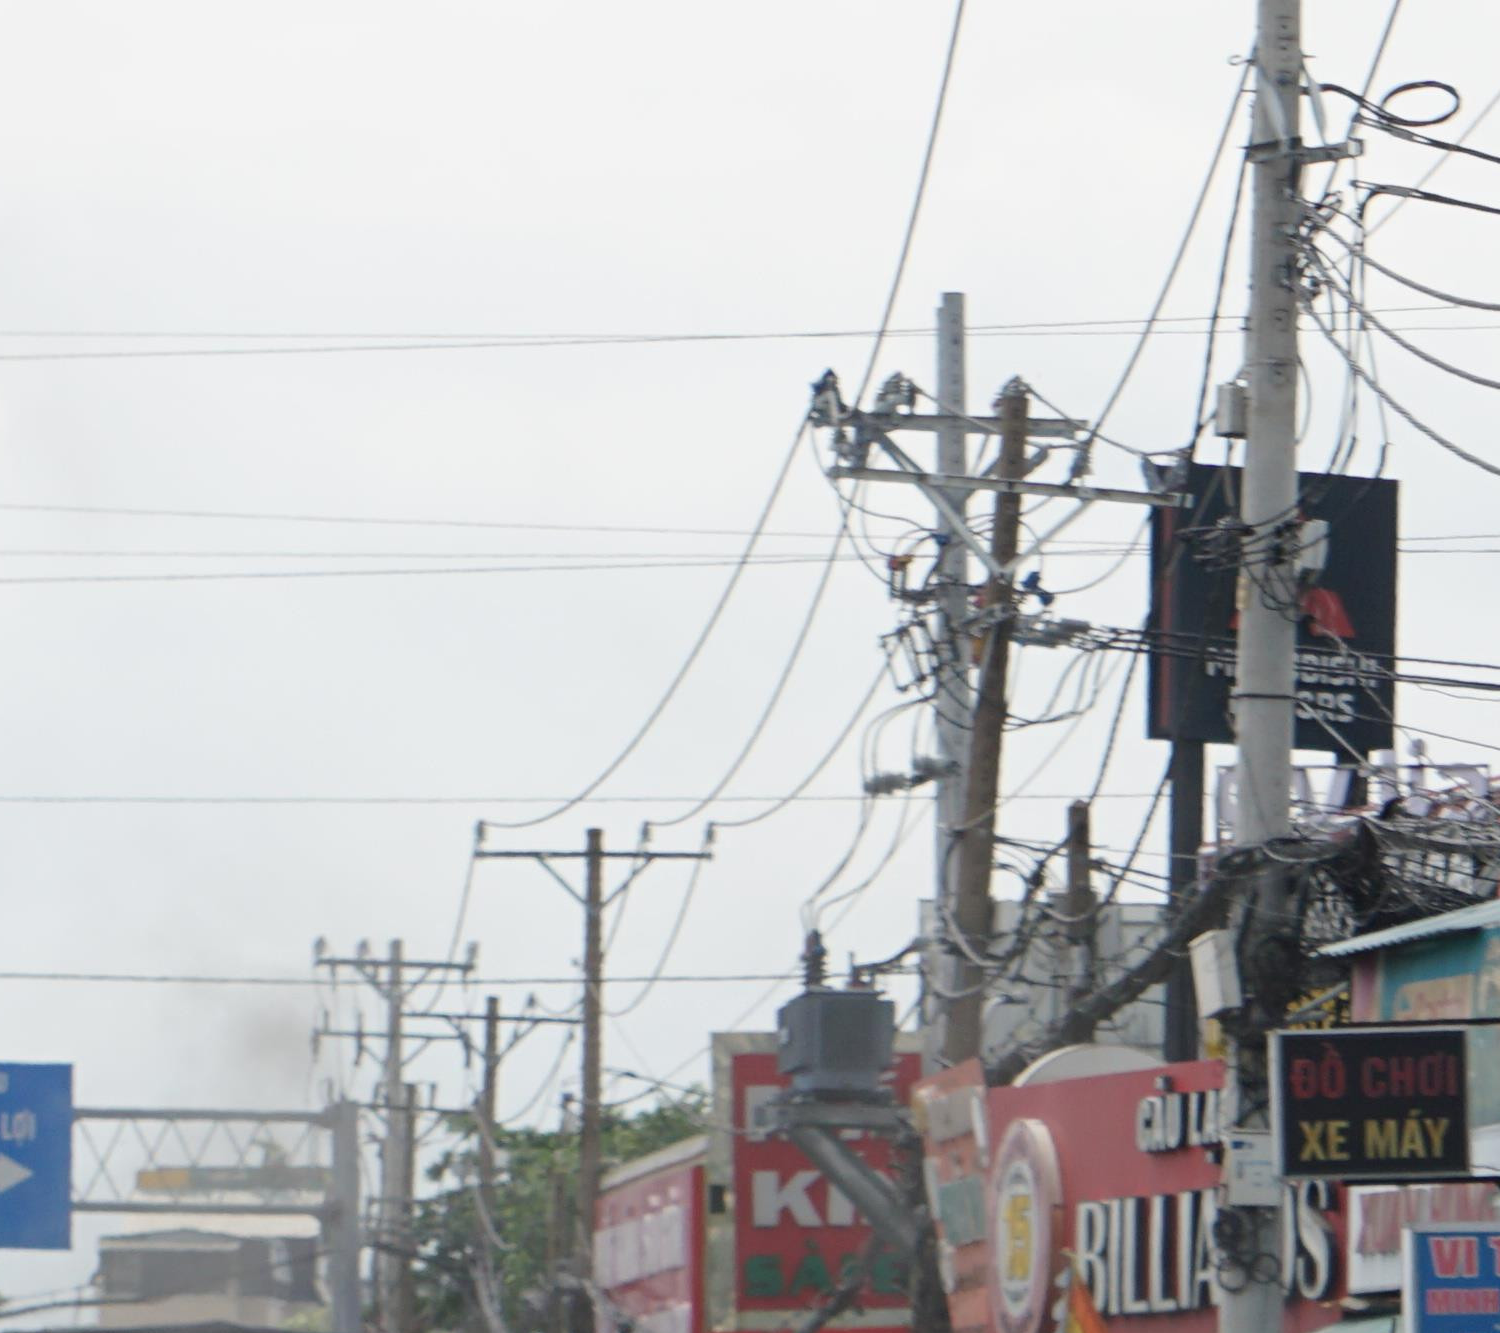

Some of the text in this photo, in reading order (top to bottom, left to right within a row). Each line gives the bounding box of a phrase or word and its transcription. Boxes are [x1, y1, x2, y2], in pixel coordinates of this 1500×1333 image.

[1289, 1041, 1457, 1099] ĐỒ CHƠI
[1, 1108, 37, 1146] LỢI
[1300, 1108, 1450, 1161] XE MÁY
[1428, 1236, 1480, 1279] VI
